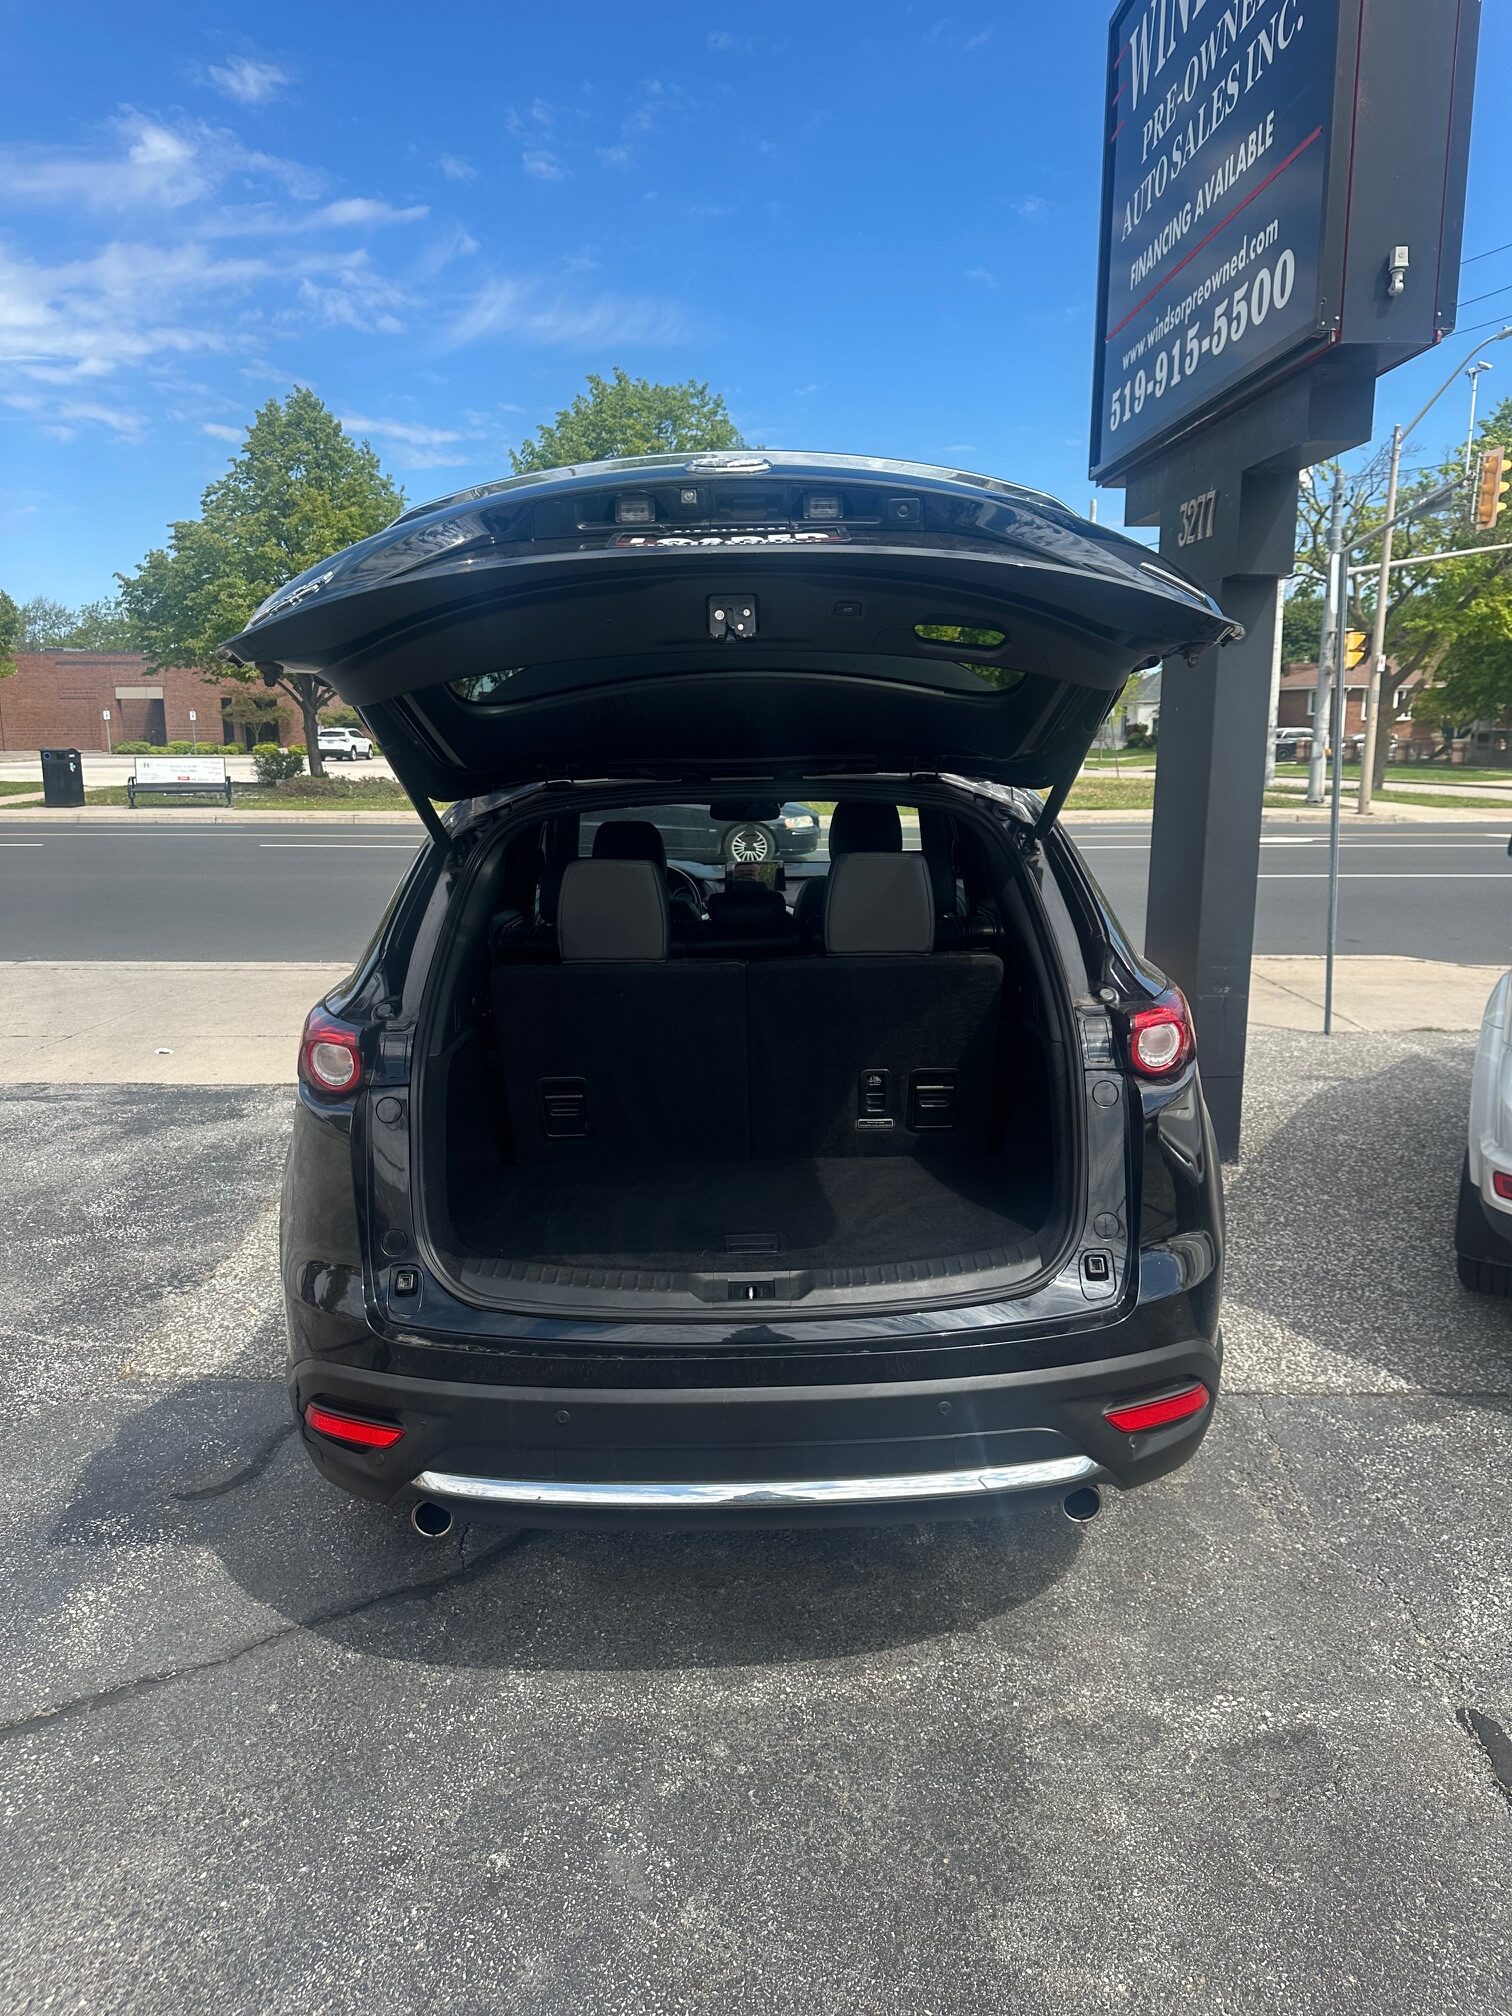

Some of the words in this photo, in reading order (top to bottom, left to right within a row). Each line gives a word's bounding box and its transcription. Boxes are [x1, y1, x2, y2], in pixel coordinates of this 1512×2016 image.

[1121, 155, 1168, 242] AUTO
[1170, 60, 1240, 182] SALES
[1244, 0, 1304, 94] INC.
[1129, 0, 1208, 112] WIN
[1141, 0, 1266, 164] PRE-OWNE
[1130, 202, 1192, 291] FINANCING
[1194, 109, 1275, 223] AVAILABLE
[1110, 249, 1295, 432] 519-915-5500
[1122, 219, 1279, 371] www.windsorpreowned.com
[1177, 489, 1217, 548] 3277
